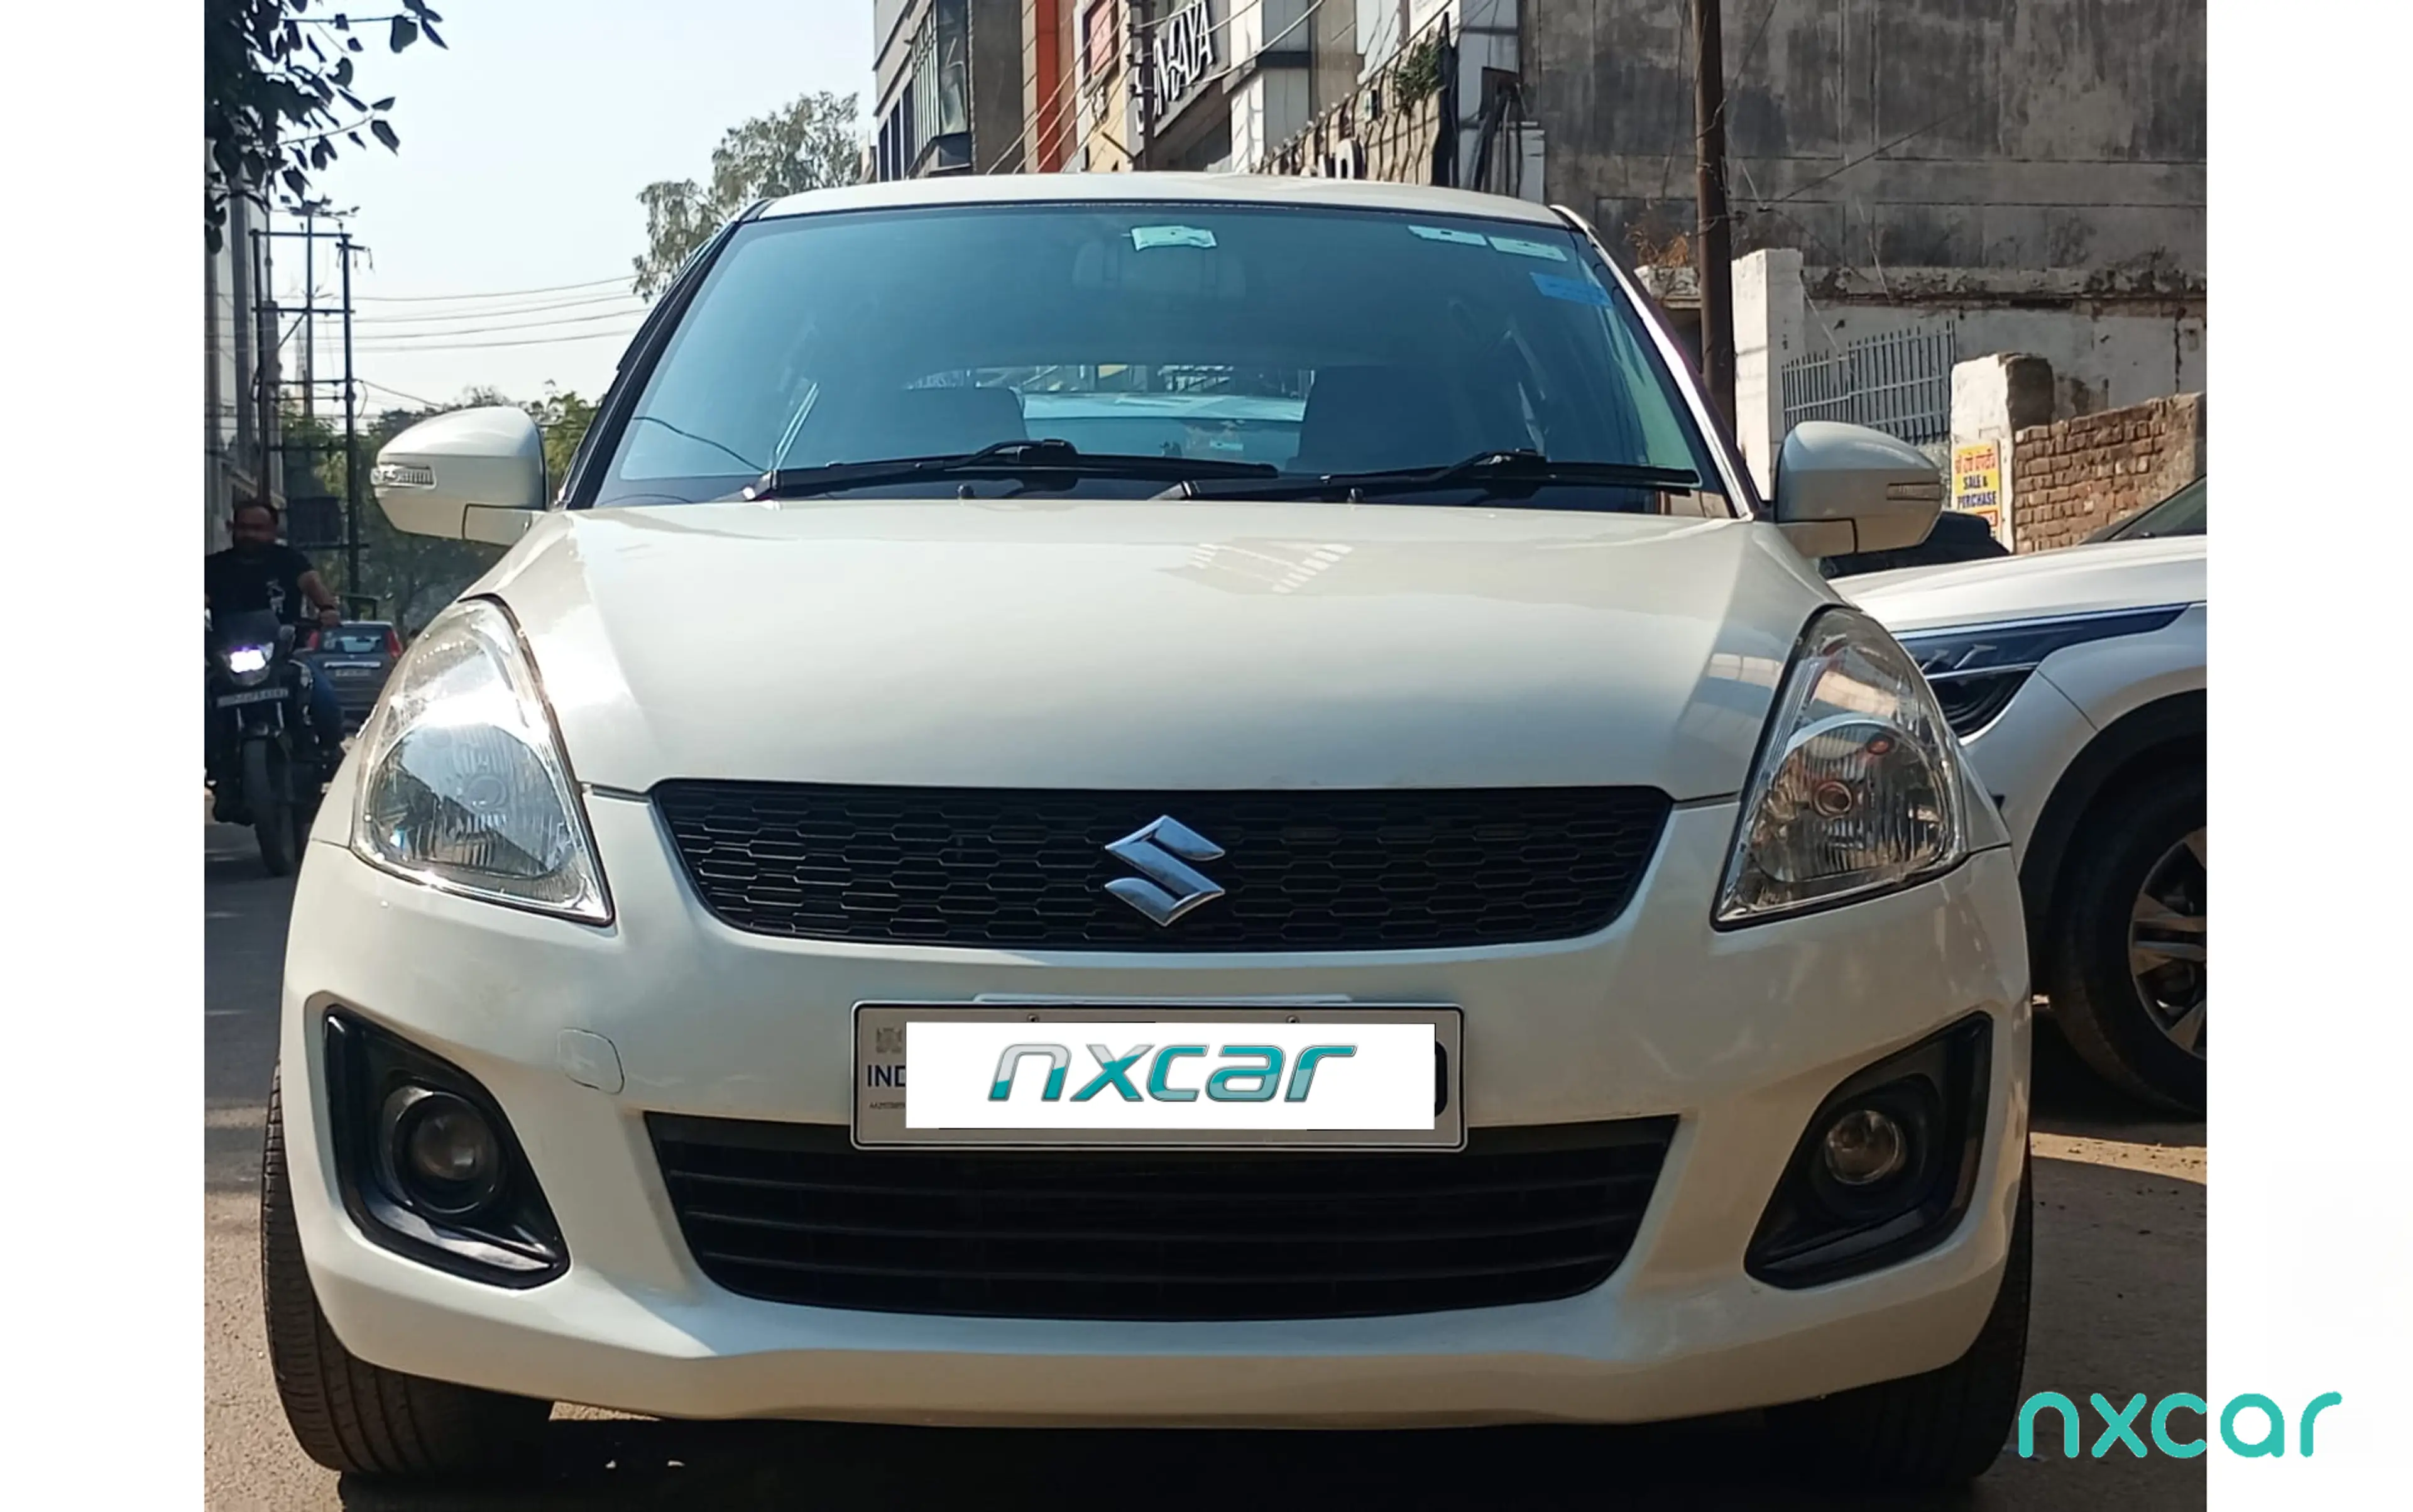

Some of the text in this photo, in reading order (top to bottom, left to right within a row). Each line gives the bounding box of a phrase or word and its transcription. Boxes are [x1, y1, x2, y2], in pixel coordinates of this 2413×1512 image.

[1963, 474, 1988, 490] SALE &
[867, 1065, 906, 1087] IND
